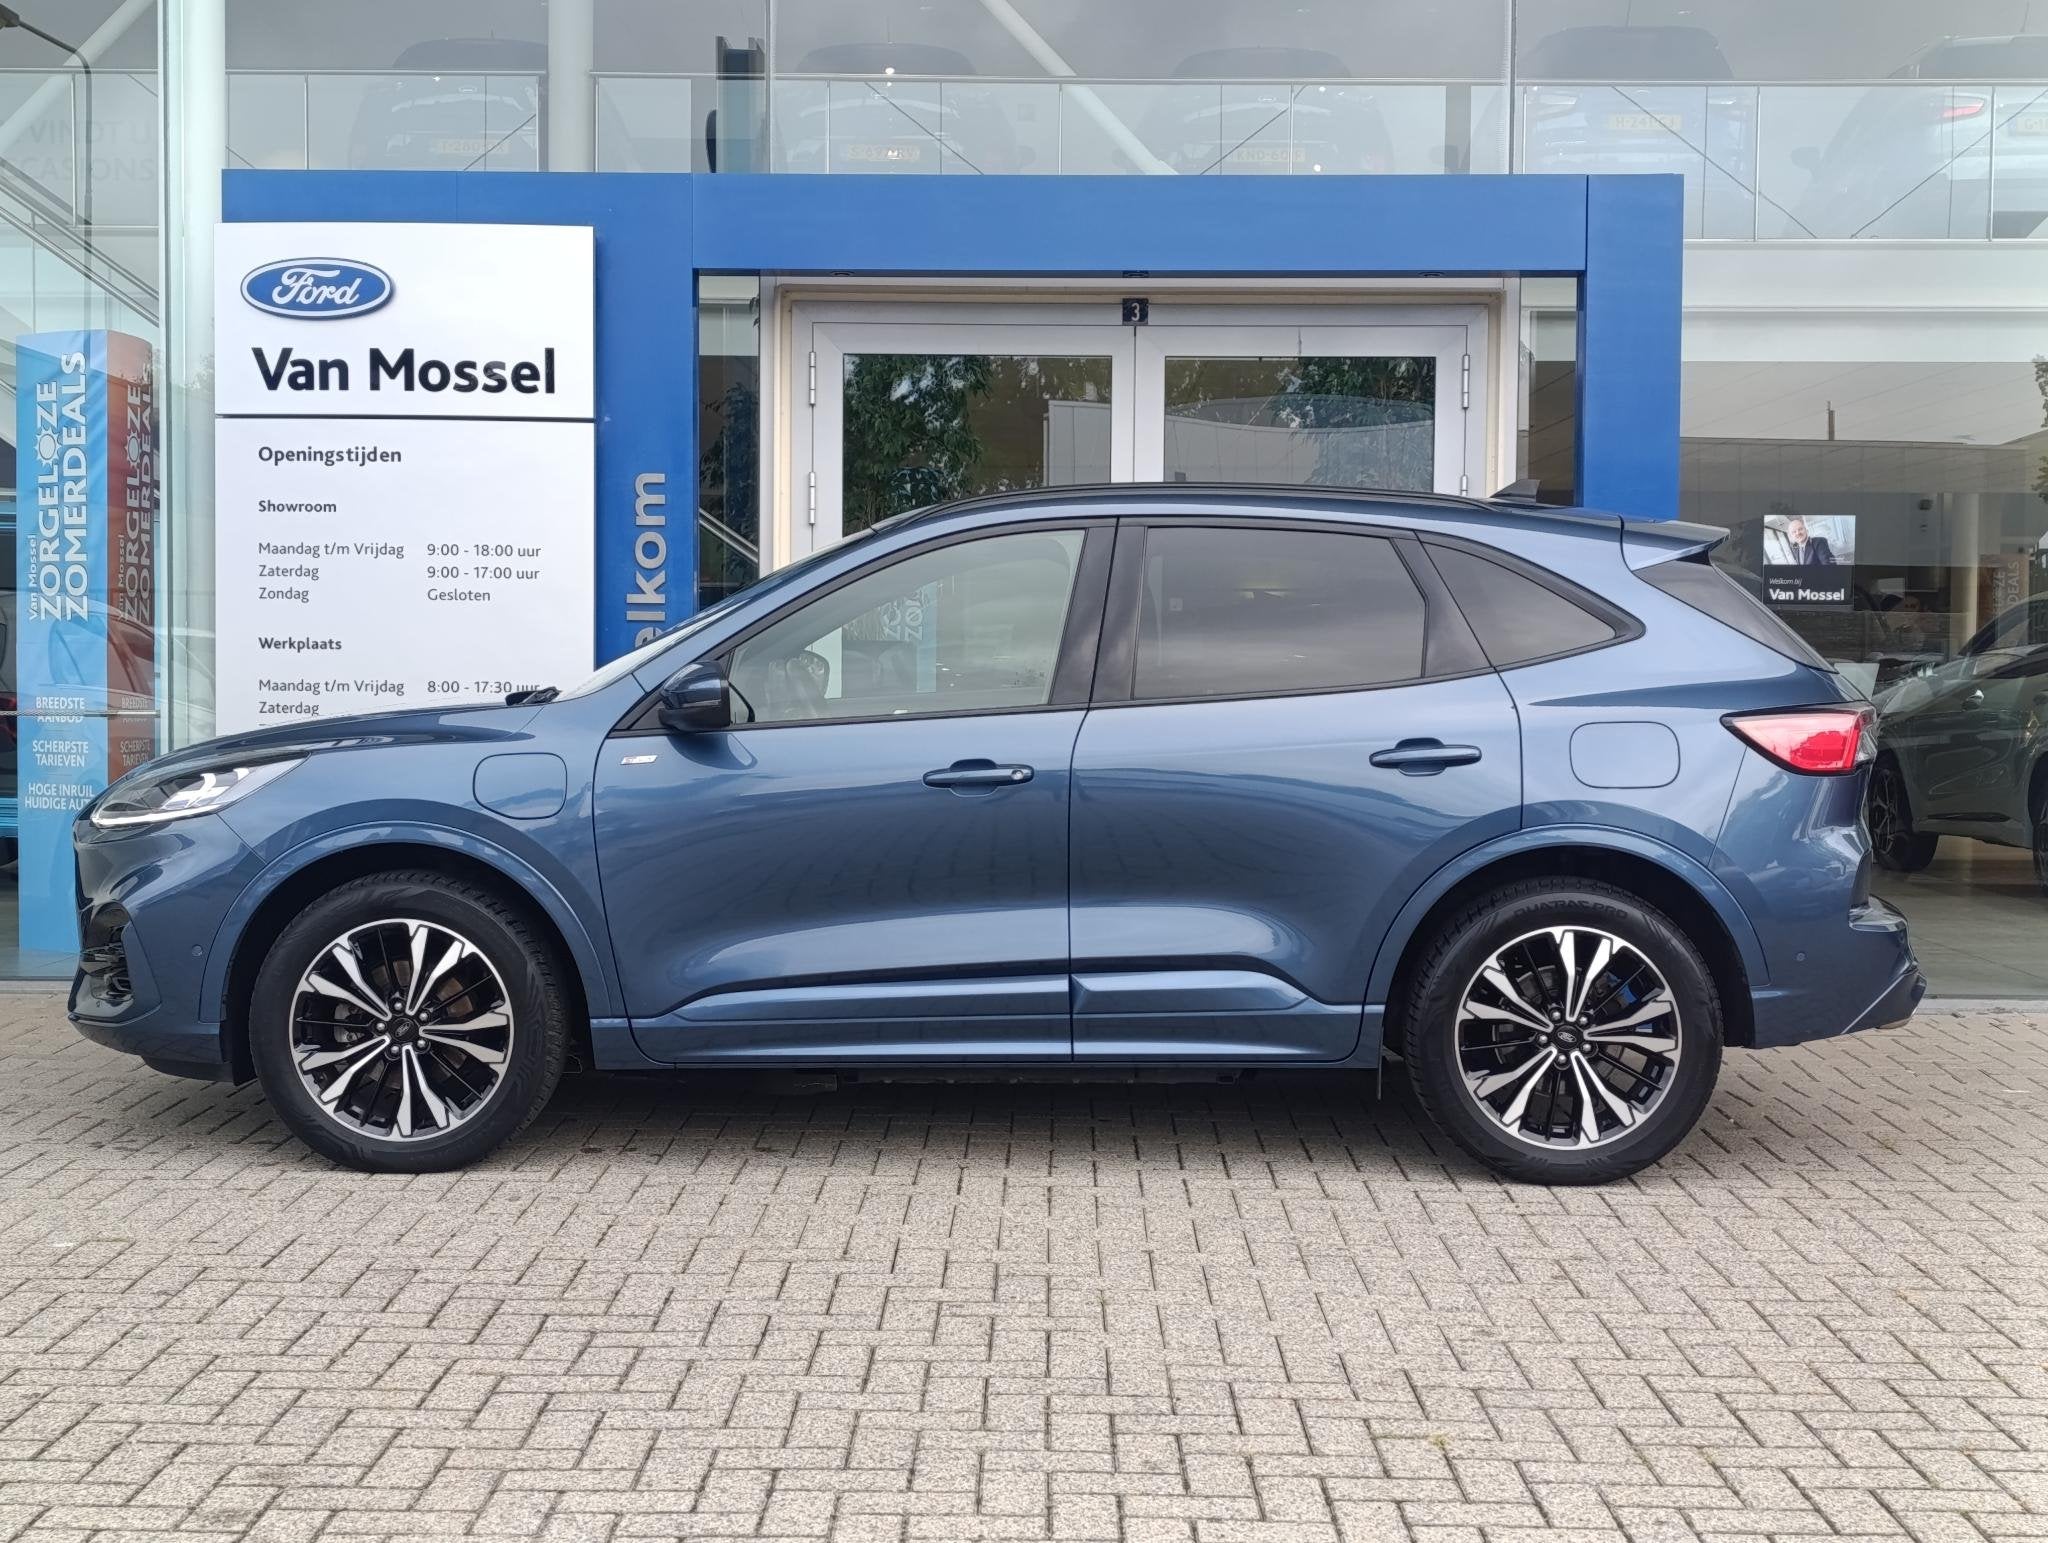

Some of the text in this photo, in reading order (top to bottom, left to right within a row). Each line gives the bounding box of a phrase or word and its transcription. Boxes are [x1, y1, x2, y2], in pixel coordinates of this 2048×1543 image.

[272, 267, 362, 307] Ford
[1131, 302, 1140, 321] 3
[251, 347, 555, 394] Van Mossel
[258, 446, 402, 467] Openingstijden
[61, 351, 88, 622] ZOMERDEALS
[258, 499, 337, 513] Showroom
[258, 542, 321, 559] Maandag
[323, 542, 350, 556] t/m
[353, 542, 405, 560] Vrijdag
[427, 543, 460, 556] 9:00
[473, 544, 514, 557] 18:00
[517, 548, 542, 557] uur
[27, 534, 38, 621] Van Mossel
[258, 564, 320, 581] Zaterdag
[427, 566, 459, 579] 9:00
[473, 566, 512, 579] 17:00
[516, 570, 540, 580] uur
[258, 586, 491, 604] Zondag Gesloten
[1769, 588, 1845, 601] Van Mossel
[258, 636, 342, 653] Werkplaats
[258, 678, 321, 696] Maandag
[324, 679, 350, 693] t/m
[353, 679, 405, 697] Vrijdag
[427, 680, 460, 693] 8:00
[473, 681, 512, 694] 17:30
[36, 696, 85, 709] BREEDSTE
[258, 700, 320, 716] Zaterdag
[32, 740, 89, 754] SCHERPSTE
[35, 753, 86, 767] TARIEVEN
[28, 782, 95, 797] HOGE INRUIL
[24, 796, 67, 810] HUIDIGE
